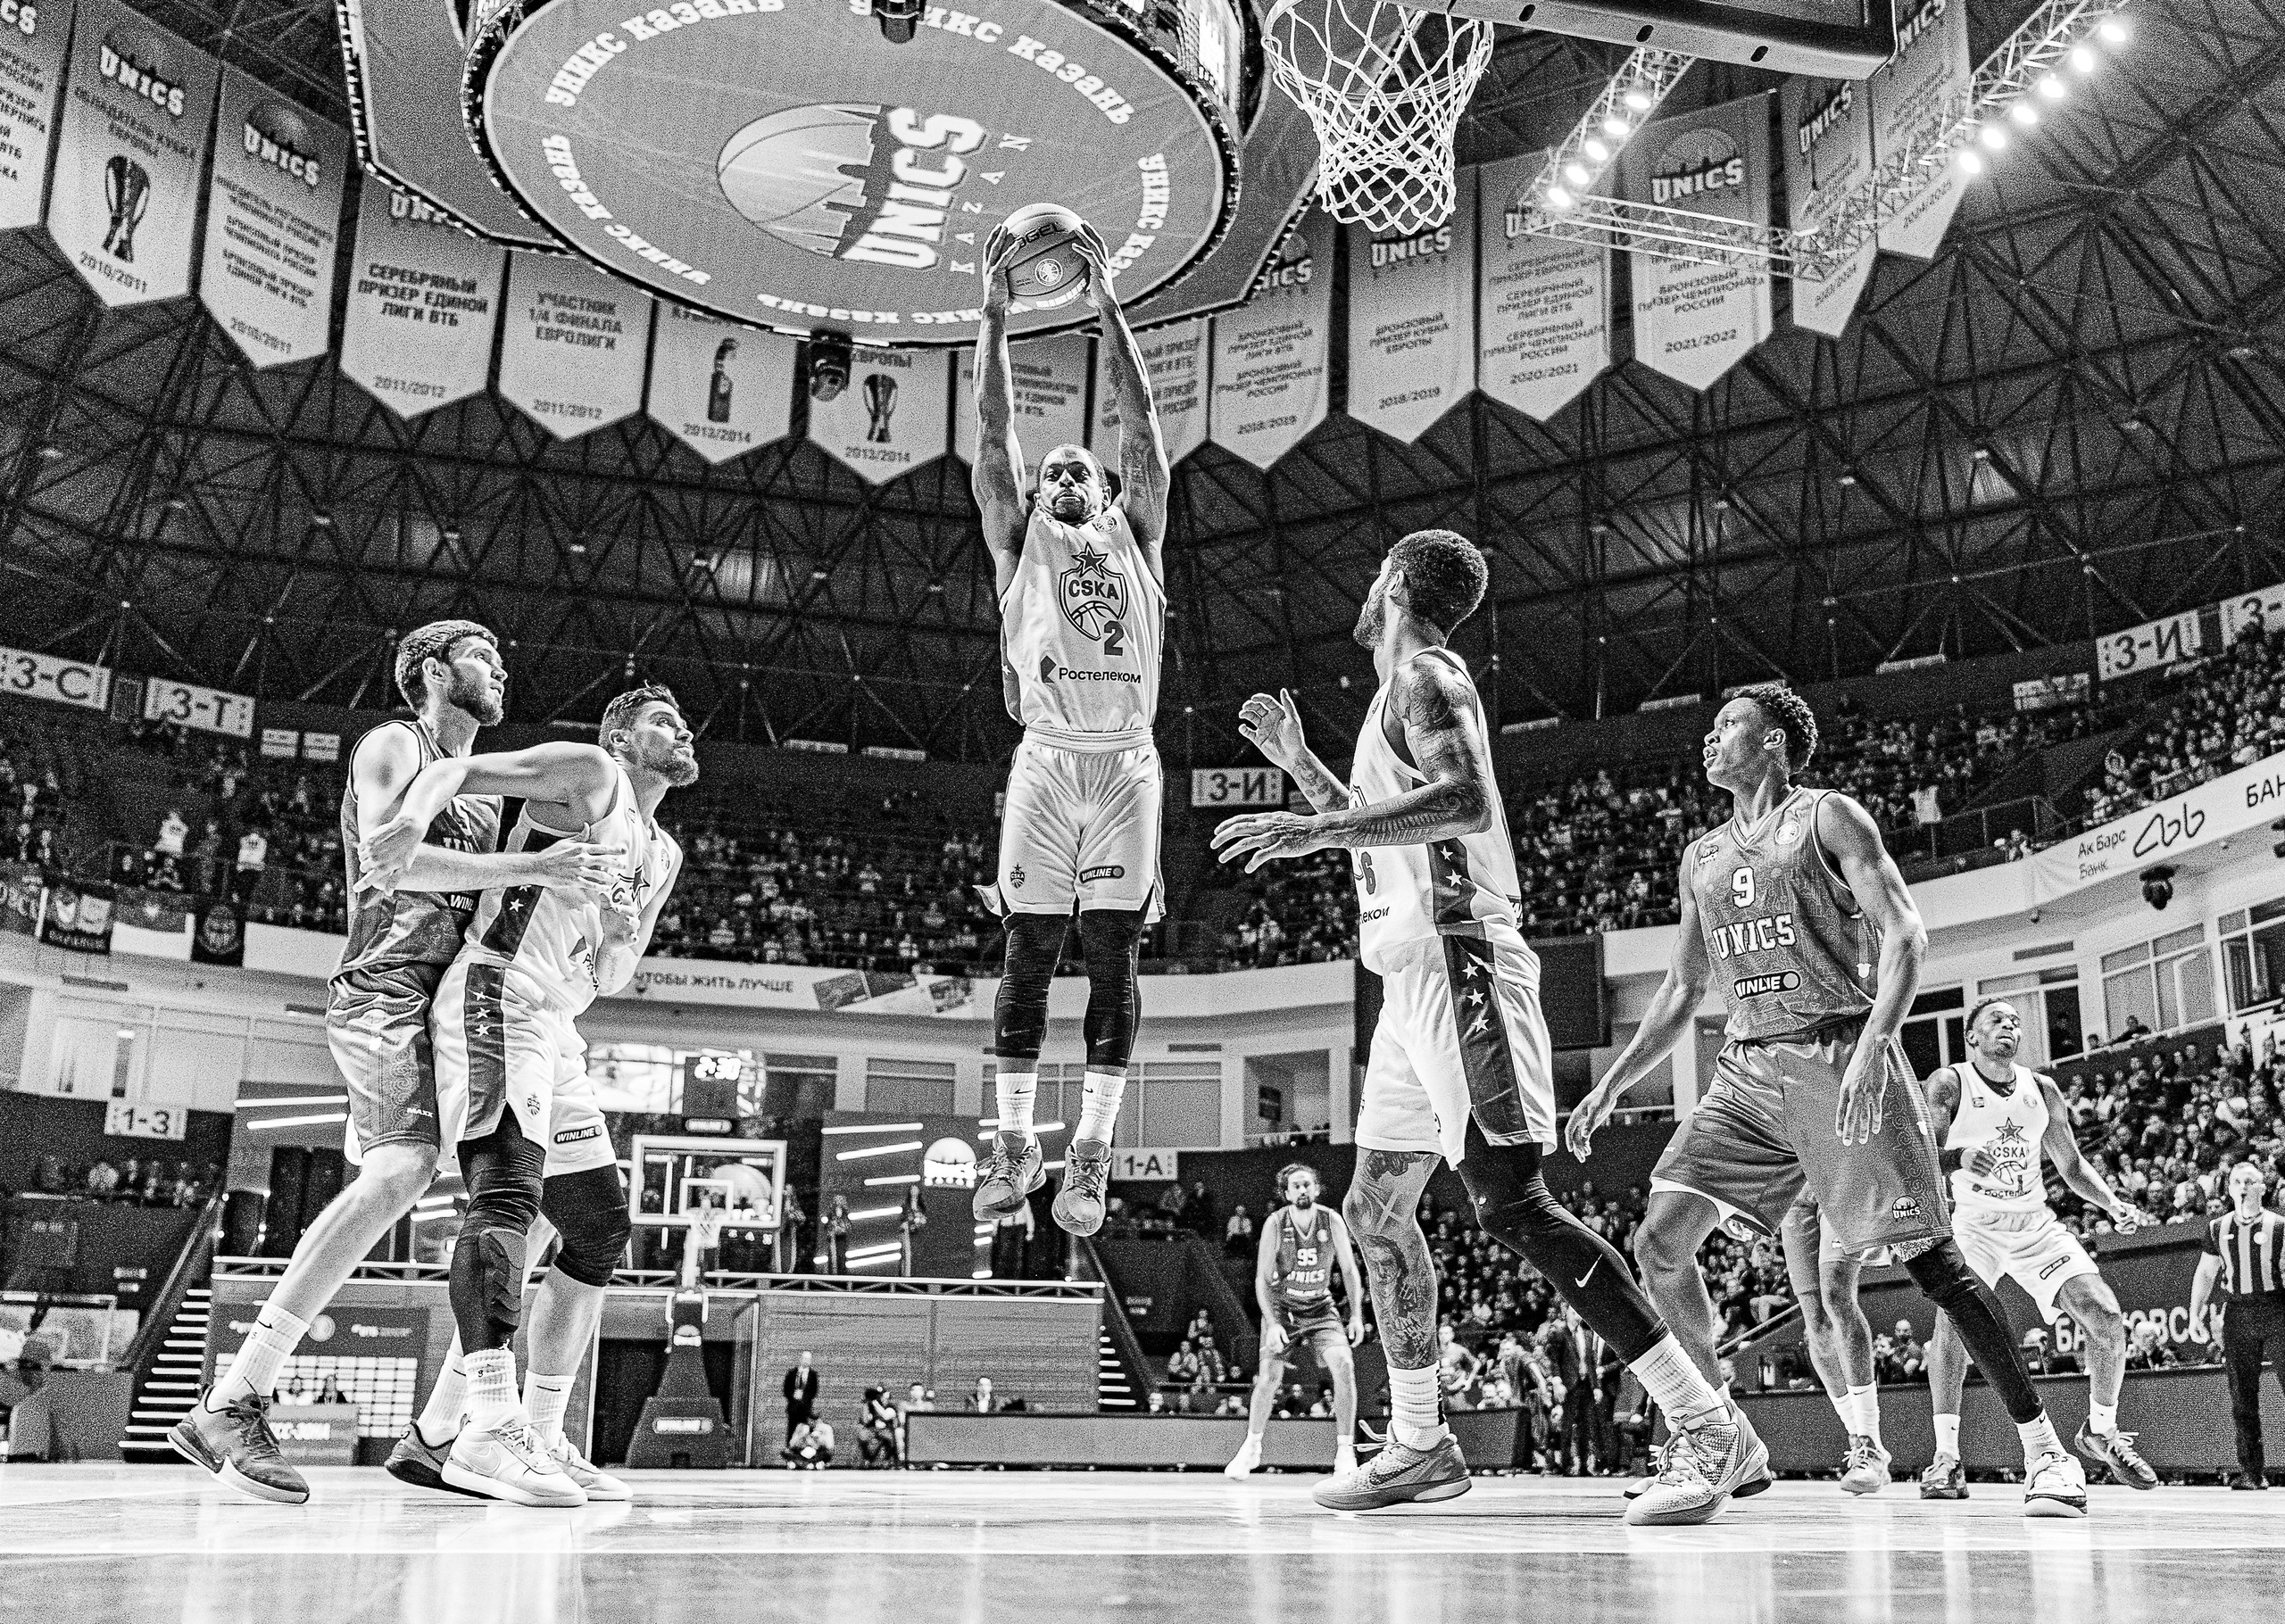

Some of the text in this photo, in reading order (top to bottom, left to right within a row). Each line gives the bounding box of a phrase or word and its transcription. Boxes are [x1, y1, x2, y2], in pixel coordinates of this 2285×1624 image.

[99, 45, 186, 116] UNICS
[1798, 80, 1853, 154] UNICS
[244, 122, 321, 186] UNICS
[839, 107, 987, 270] UNICS
[1651, 156, 1744, 204] UNICS
[1015, 222, 1067, 249] OGEL
[1371, 226, 1452, 267] UNICS
[79, 250, 148, 295] 2010/2011
[368, 262, 477, 294] СЕРЕБРЯНЫЙ
[357, 278, 489, 314] ПРИЗЕР ЕДИНОЙ
[536, 291, 617, 316] УЧАСТНИК
[381, 302, 460, 327] ЛИГИ ВТБ
[528, 308, 624, 335] 1/4 ФИНАЛА
[229, 316, 293, 354] 2010/2011
[535, 326, 617, 351] ЕВРОЛИГИ
[1664, 327, 1739, 353] 2021/2022
[373, 375, 446, 399] 2011/2012
[532, 398, 603, 420] 2011/2012
[1068, 579, 1119, 600] CSKA
[1103, 619, 1124, 657] 2
[2114, 618, 2184, 671] 3-И
[1059, 667, 1142, 684] Ростелеком
[1208, 772, 1268, 802] 3-И
[1731, 865, 1757, 908] 9
[1711, 912, 1798, 961] UNICS
[556, 1127, 595, 1142] WINLINE
[1992, 1146, 2026, 1159] CSKA
[1892, 1206, 1921, 1219] UNICS
[1297, 1247, 1318, 1267] 95
